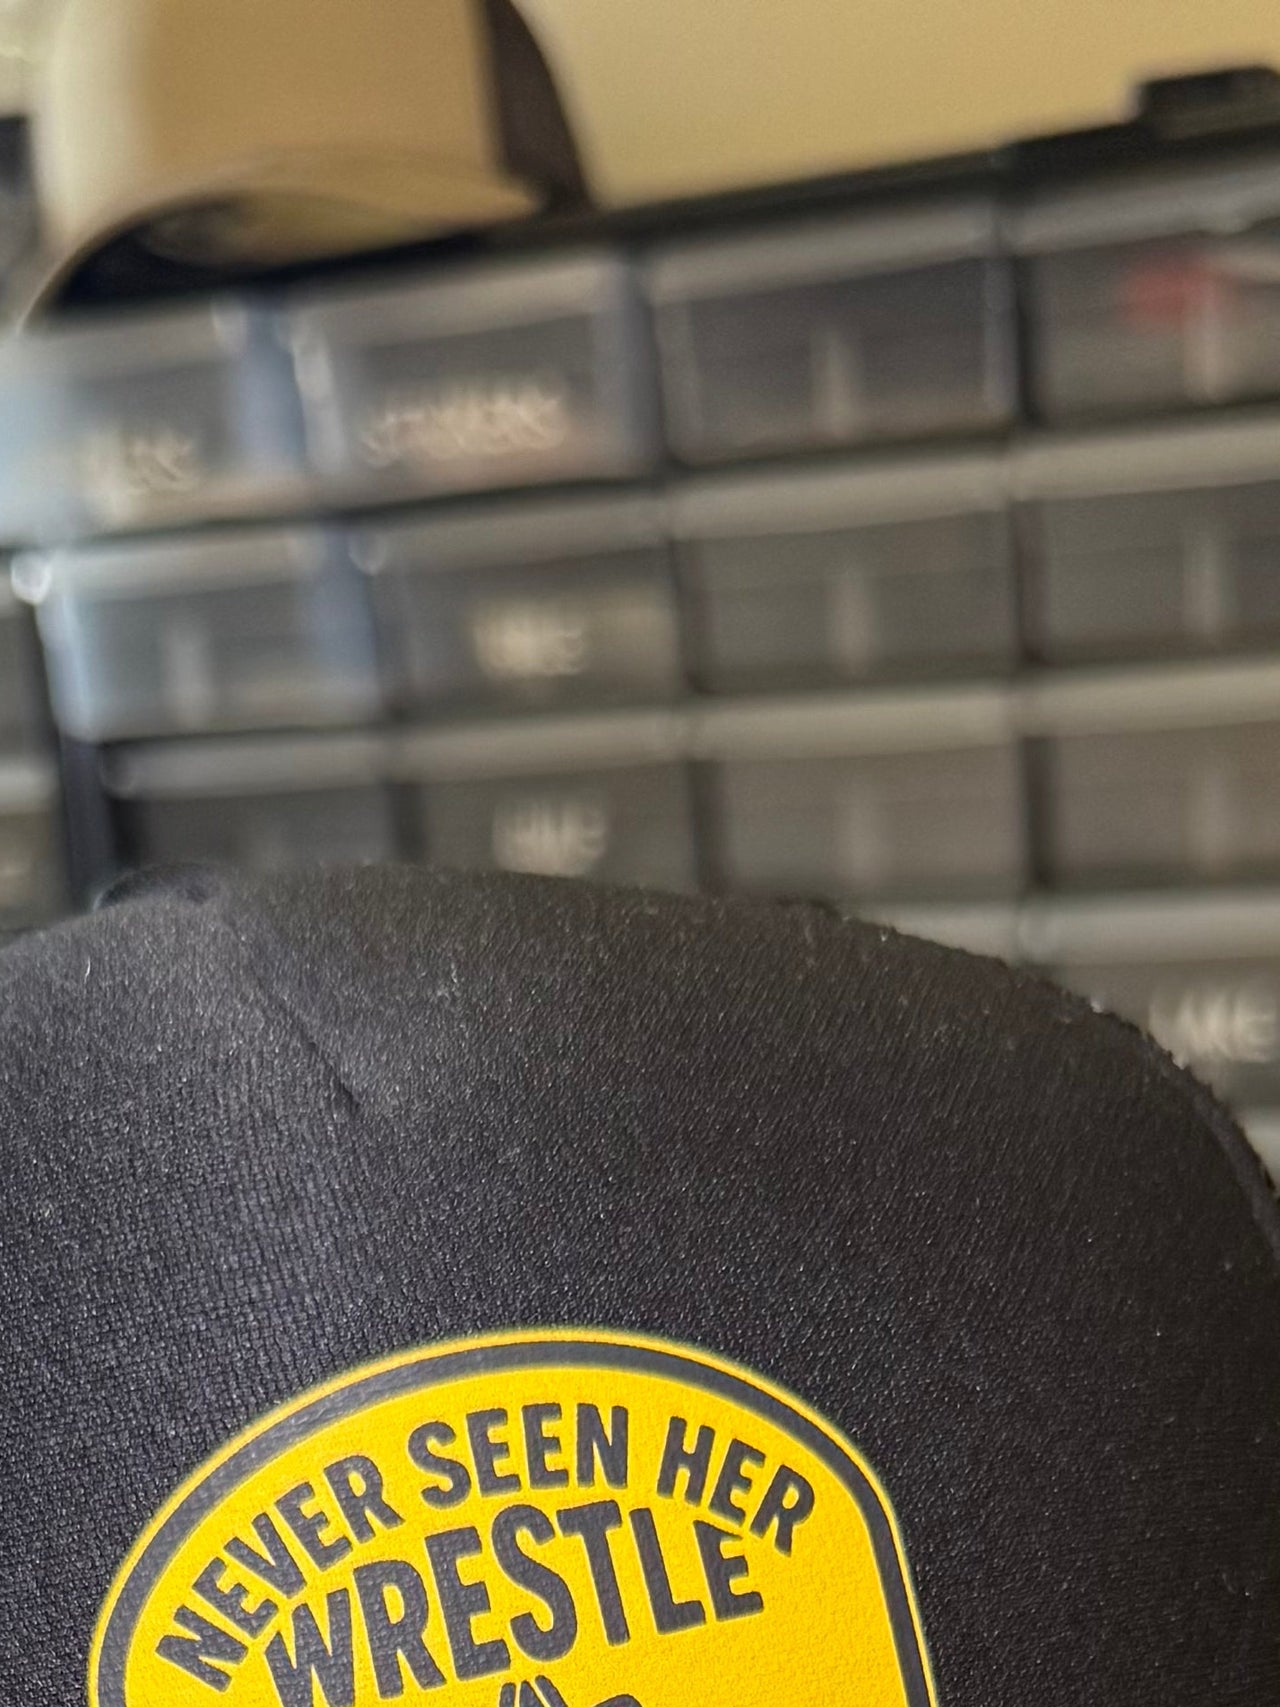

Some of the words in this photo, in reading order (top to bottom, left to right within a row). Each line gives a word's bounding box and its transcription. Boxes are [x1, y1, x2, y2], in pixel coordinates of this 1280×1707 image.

[156, 1452, 405, 1691] NEVER
[408, 1403, 630, 1507] SEEN
[658, 1414, 816, 1556] HER
